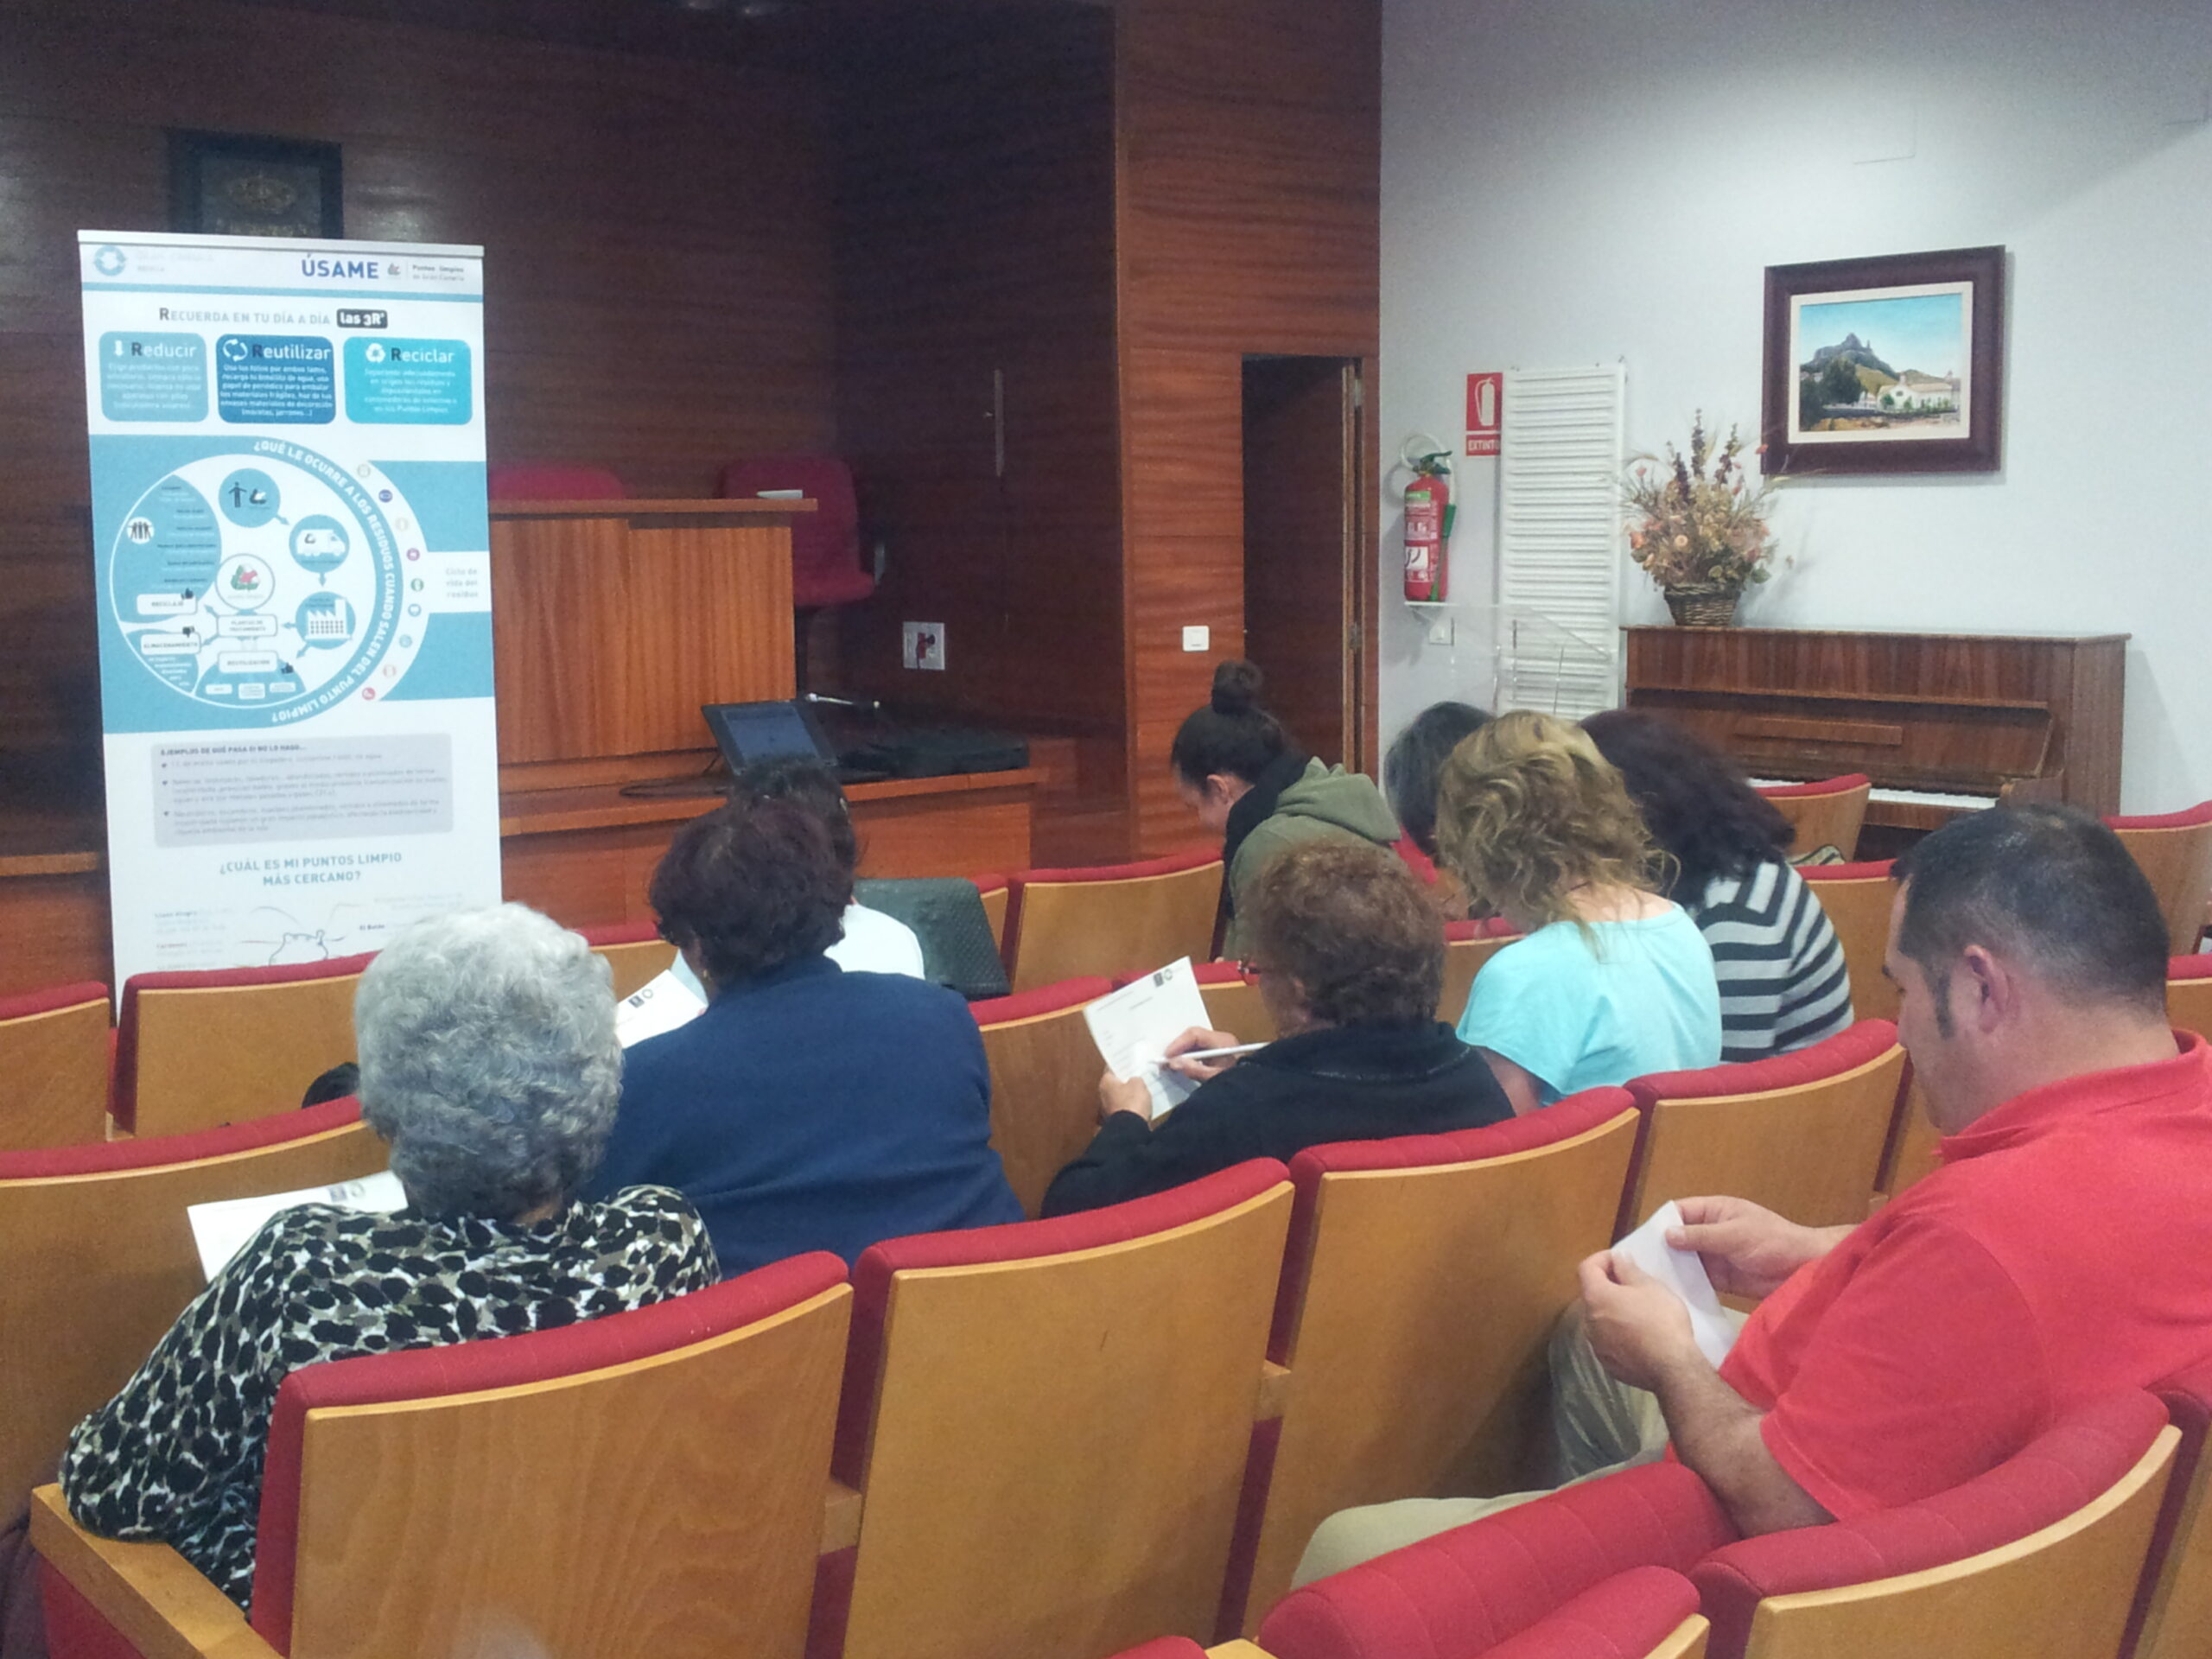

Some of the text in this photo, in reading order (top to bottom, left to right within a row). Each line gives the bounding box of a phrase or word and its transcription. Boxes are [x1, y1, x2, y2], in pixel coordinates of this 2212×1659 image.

[302, 253, 379, 279] ÚSAME
[159, 307, 230, 322] RECUERDA
[233, 312, 250, 323] EN
[253, 313, 270, 324] TU
[273, 311, 295, 324] DÍA
[298, 313, 307, 325] A
[309, 312, 331, 325] DÍA
[340, 311, 361, 325] las
[131, 341, 197, 359] Reducir
[252, 343, 332, 360] Reutilizar
[391, 347, 455, 363] Reciclar
[253, 440, 286, 454] ¿QUÉ
[288, 447, 304, 461] LE
[304, 454, 347, 488] OCURRE
[344, 486, 355, 495] A
[352, 493, 372, 515] LOS
[366, 514, 395, 570] RESIDUOS
[381, 573, 396, 620] CUANDO
[366, 620, 390, 657] SALEN
[351, 656, 372, 675] DEL
[319, 675, 354, 704] PUNTO
[219, 851, 402, 875] ¿CUÁL ES MI PUNTOS LIMPIO
[263, 870, 362, 887] MÁS CERCANO?
